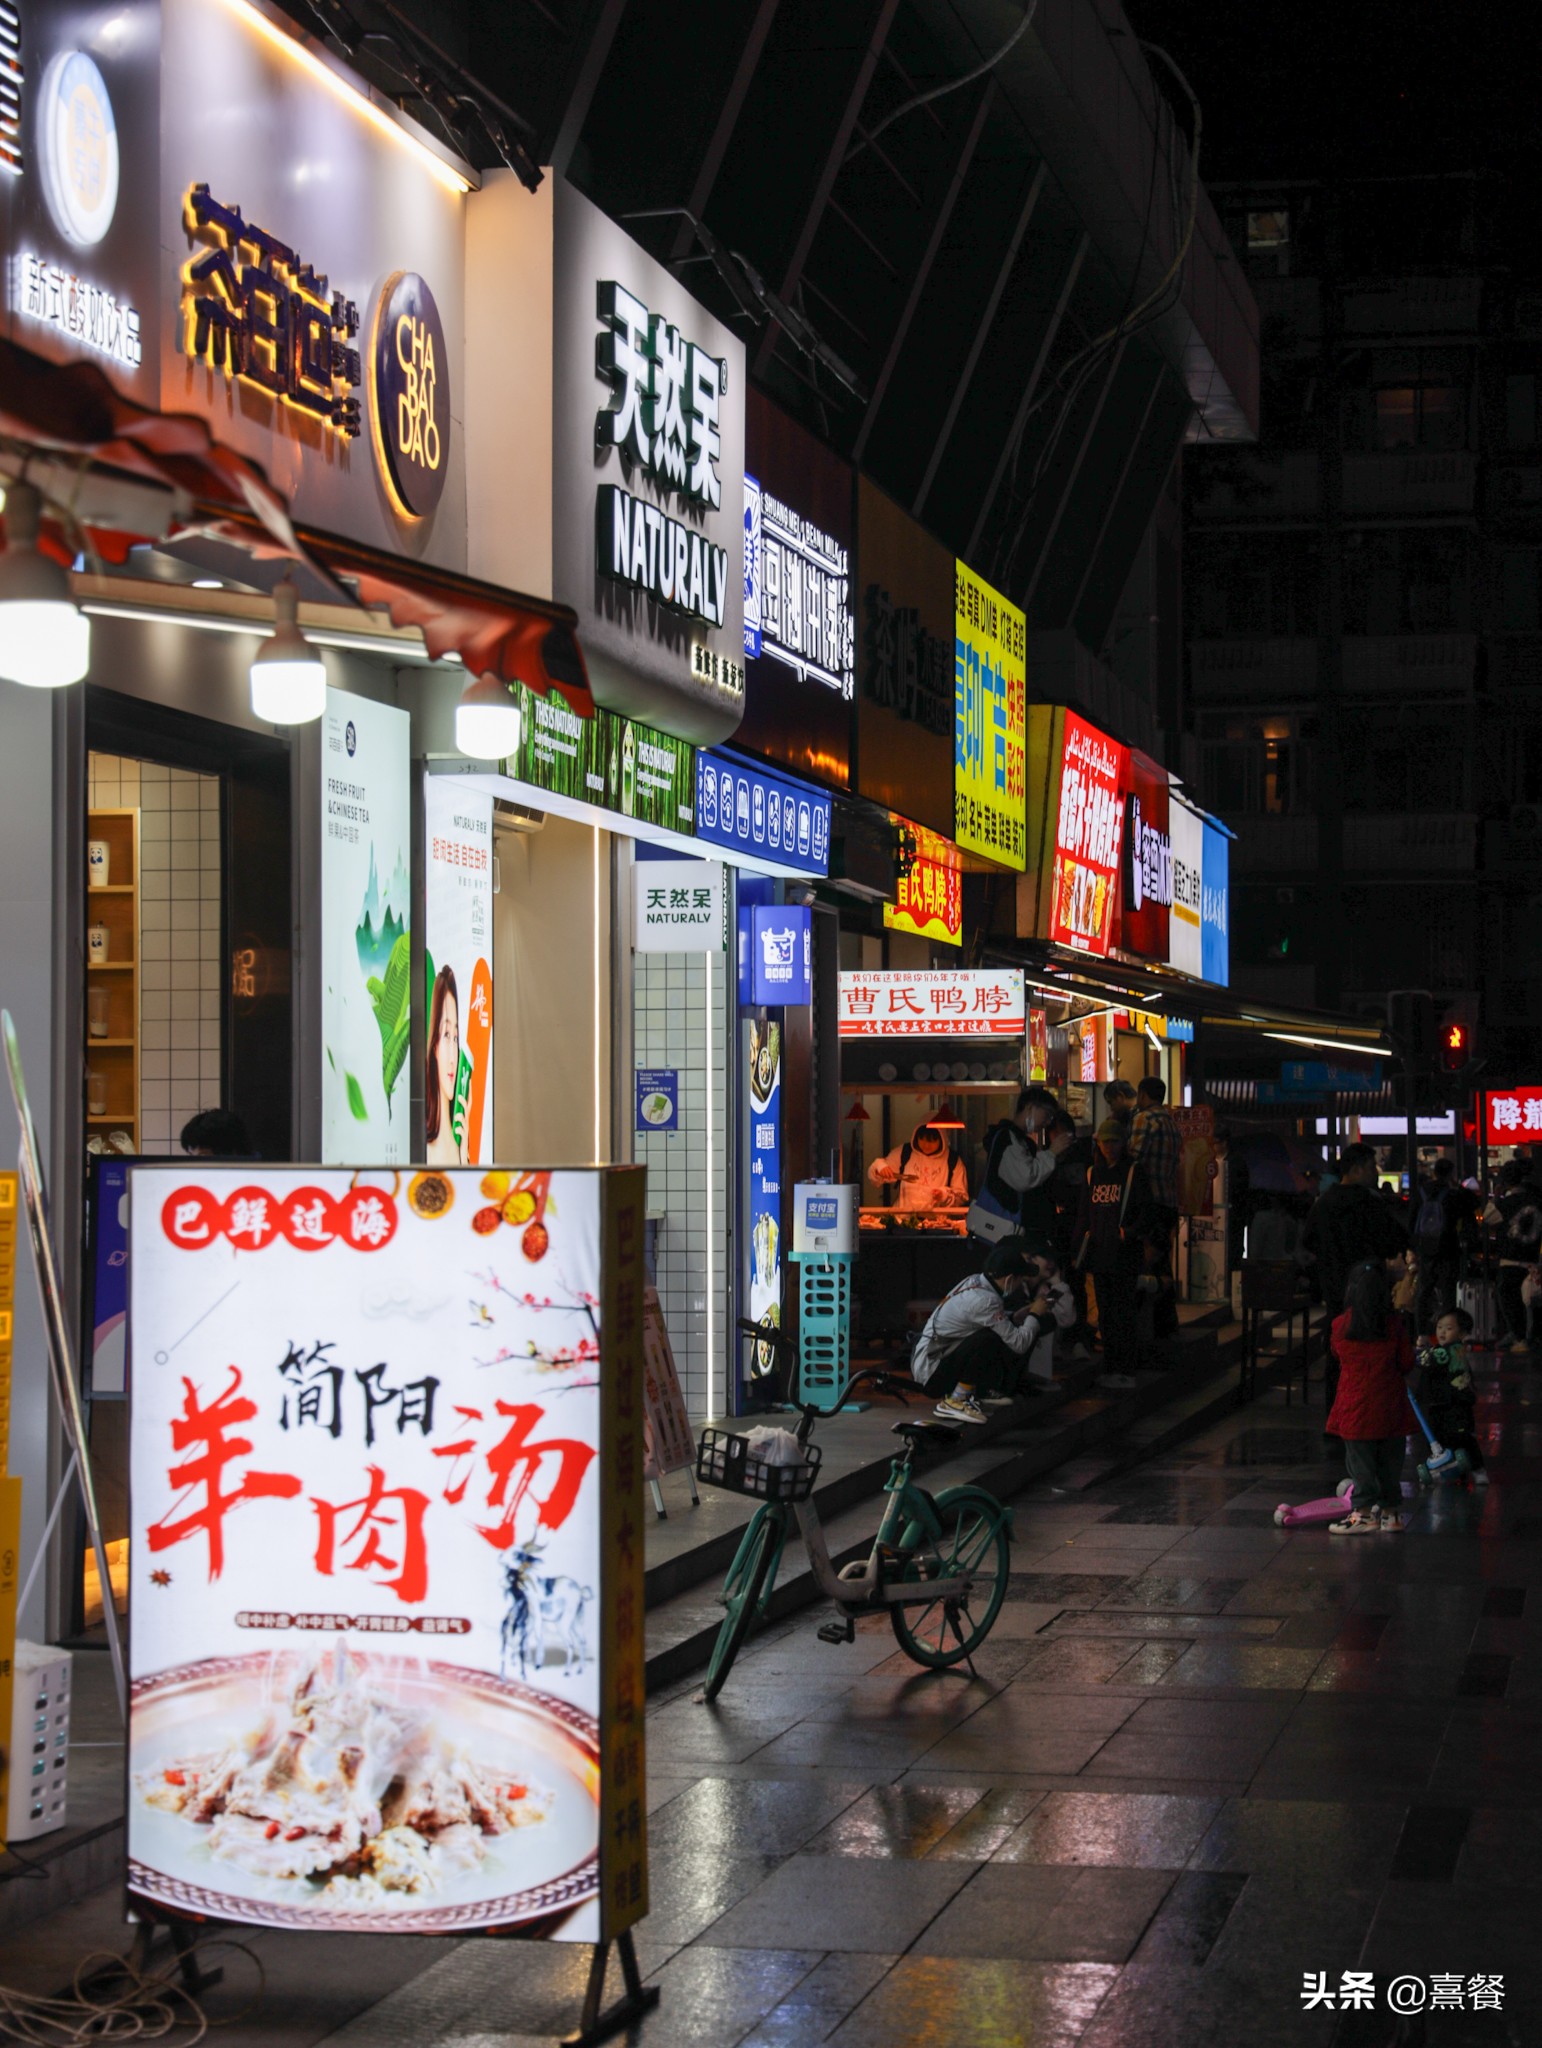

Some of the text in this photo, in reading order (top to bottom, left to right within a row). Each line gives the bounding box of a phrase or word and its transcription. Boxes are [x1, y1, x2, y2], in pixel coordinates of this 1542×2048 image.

[22, 253, 142, 368] 新式酸奶饮品
[396, 313, 436, 385] CHA
[612, 281, 722, 510] 天然呆
[398, 392, 441, 470] DAO
[763, 491, 840, 562] SHUANG MEI BEAN MILK
[328, 778, 366, 802] FRESH FRUIT
[328, 800, 370, 825] &CHINESE TEA
[969, 796, 983, 844] 名片
[646, 888, 712, 909] 天然呆
[841, 984, 1013, 1015] 曹氏鸭脖
[808, 1203, 837, 1214] 支付宝
[1091, 1193, 1121, 1204] OCEAN
[1092, 1184, 1122, 1194] NORTH
[172, 1198, 394, 1246] 巴鲜过海
[277, 1339, 441, 1449] 简阳
[147, 1364, 599, 1605] 羊肉汤
[296, 1614, 350, 1630] 补中益气
